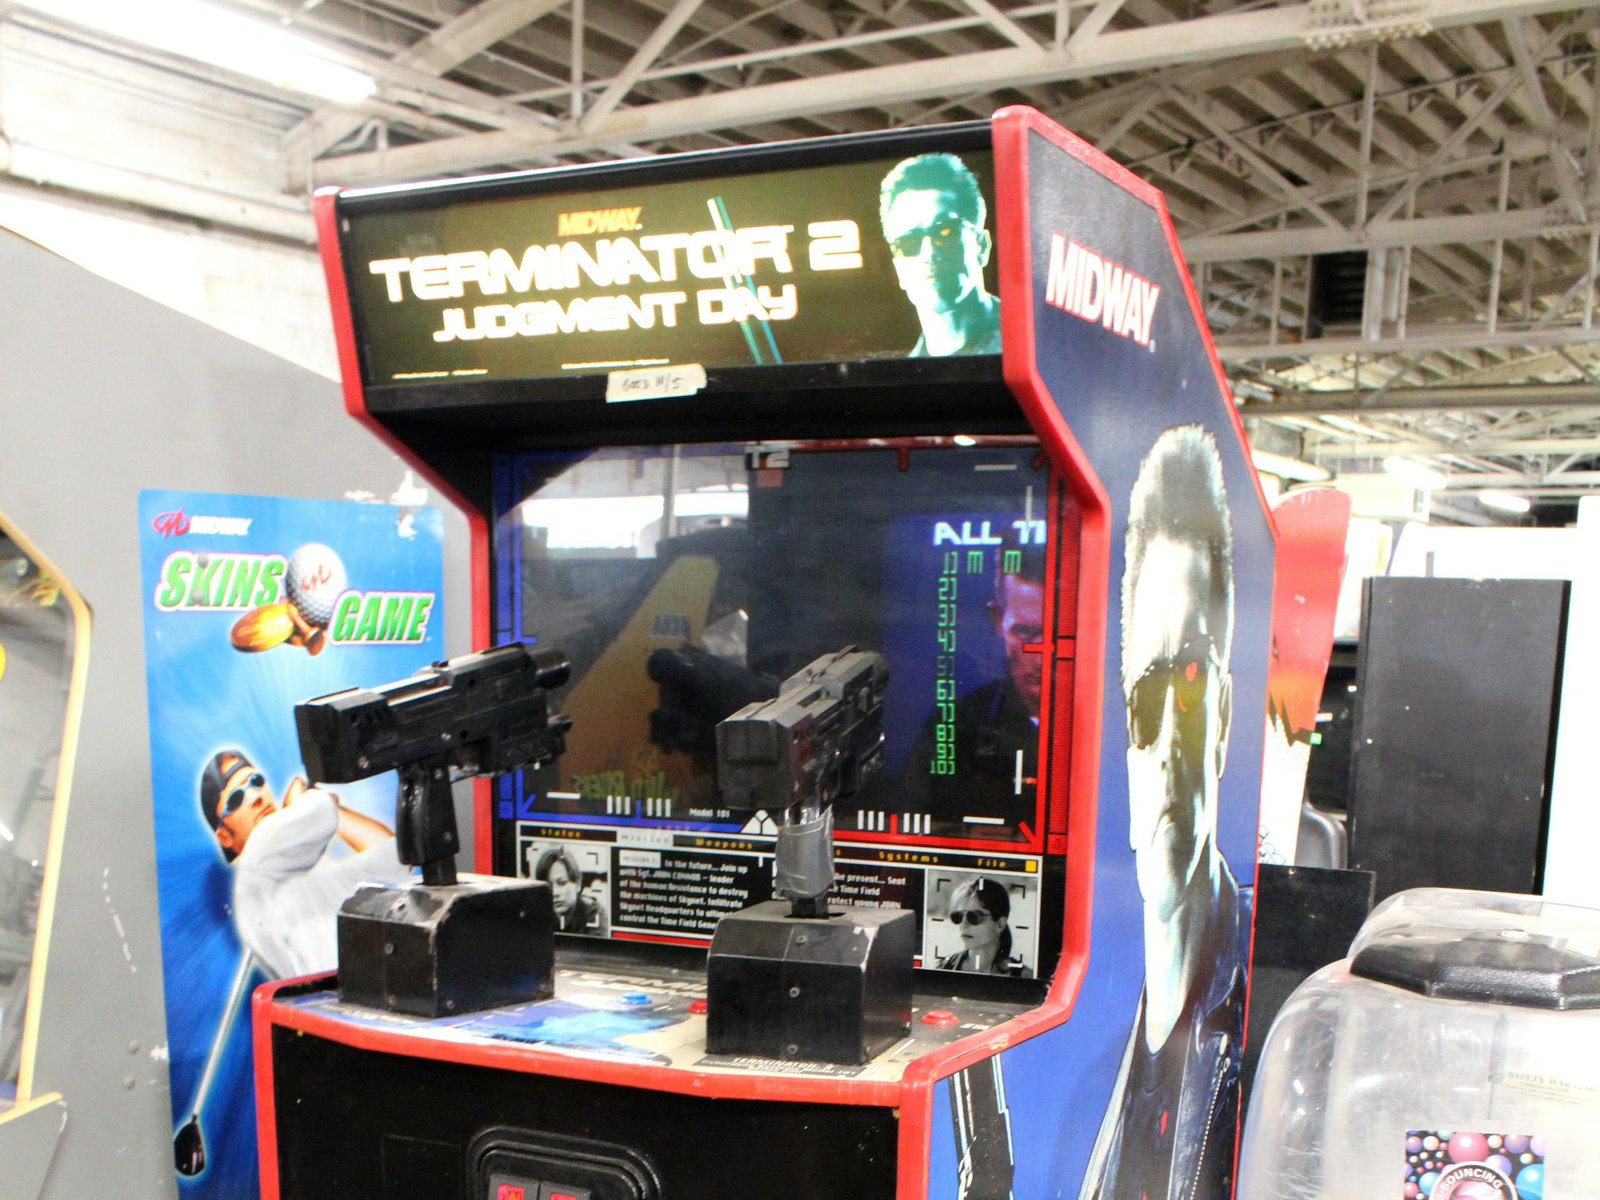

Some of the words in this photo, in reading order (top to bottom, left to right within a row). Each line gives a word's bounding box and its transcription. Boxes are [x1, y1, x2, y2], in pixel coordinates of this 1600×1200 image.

[557, 206, 642, 236] MIDWAY
[368, 224, 793, 303] TERMINATOR
[807, 220, 864, 271] 2
[1045, 230, 1161, 347] MIDWAY
[433, 291, 687, 342] JUDGMENT
[697, 283, 798, 325] DAY
[933, 521, 1003, 545] ALL
[156, 552, 286, 610] SKINS
[328, 591, 435, 644] GAME
[689, 808, 713, 818] Model
[716, 810, 730, 818] 101
[540, 828, 582, 838] Status
[695, 838, 754, 850] Weapons
[878, 851, 939, 863] Systems
[977, 858, 1007, 868] File
